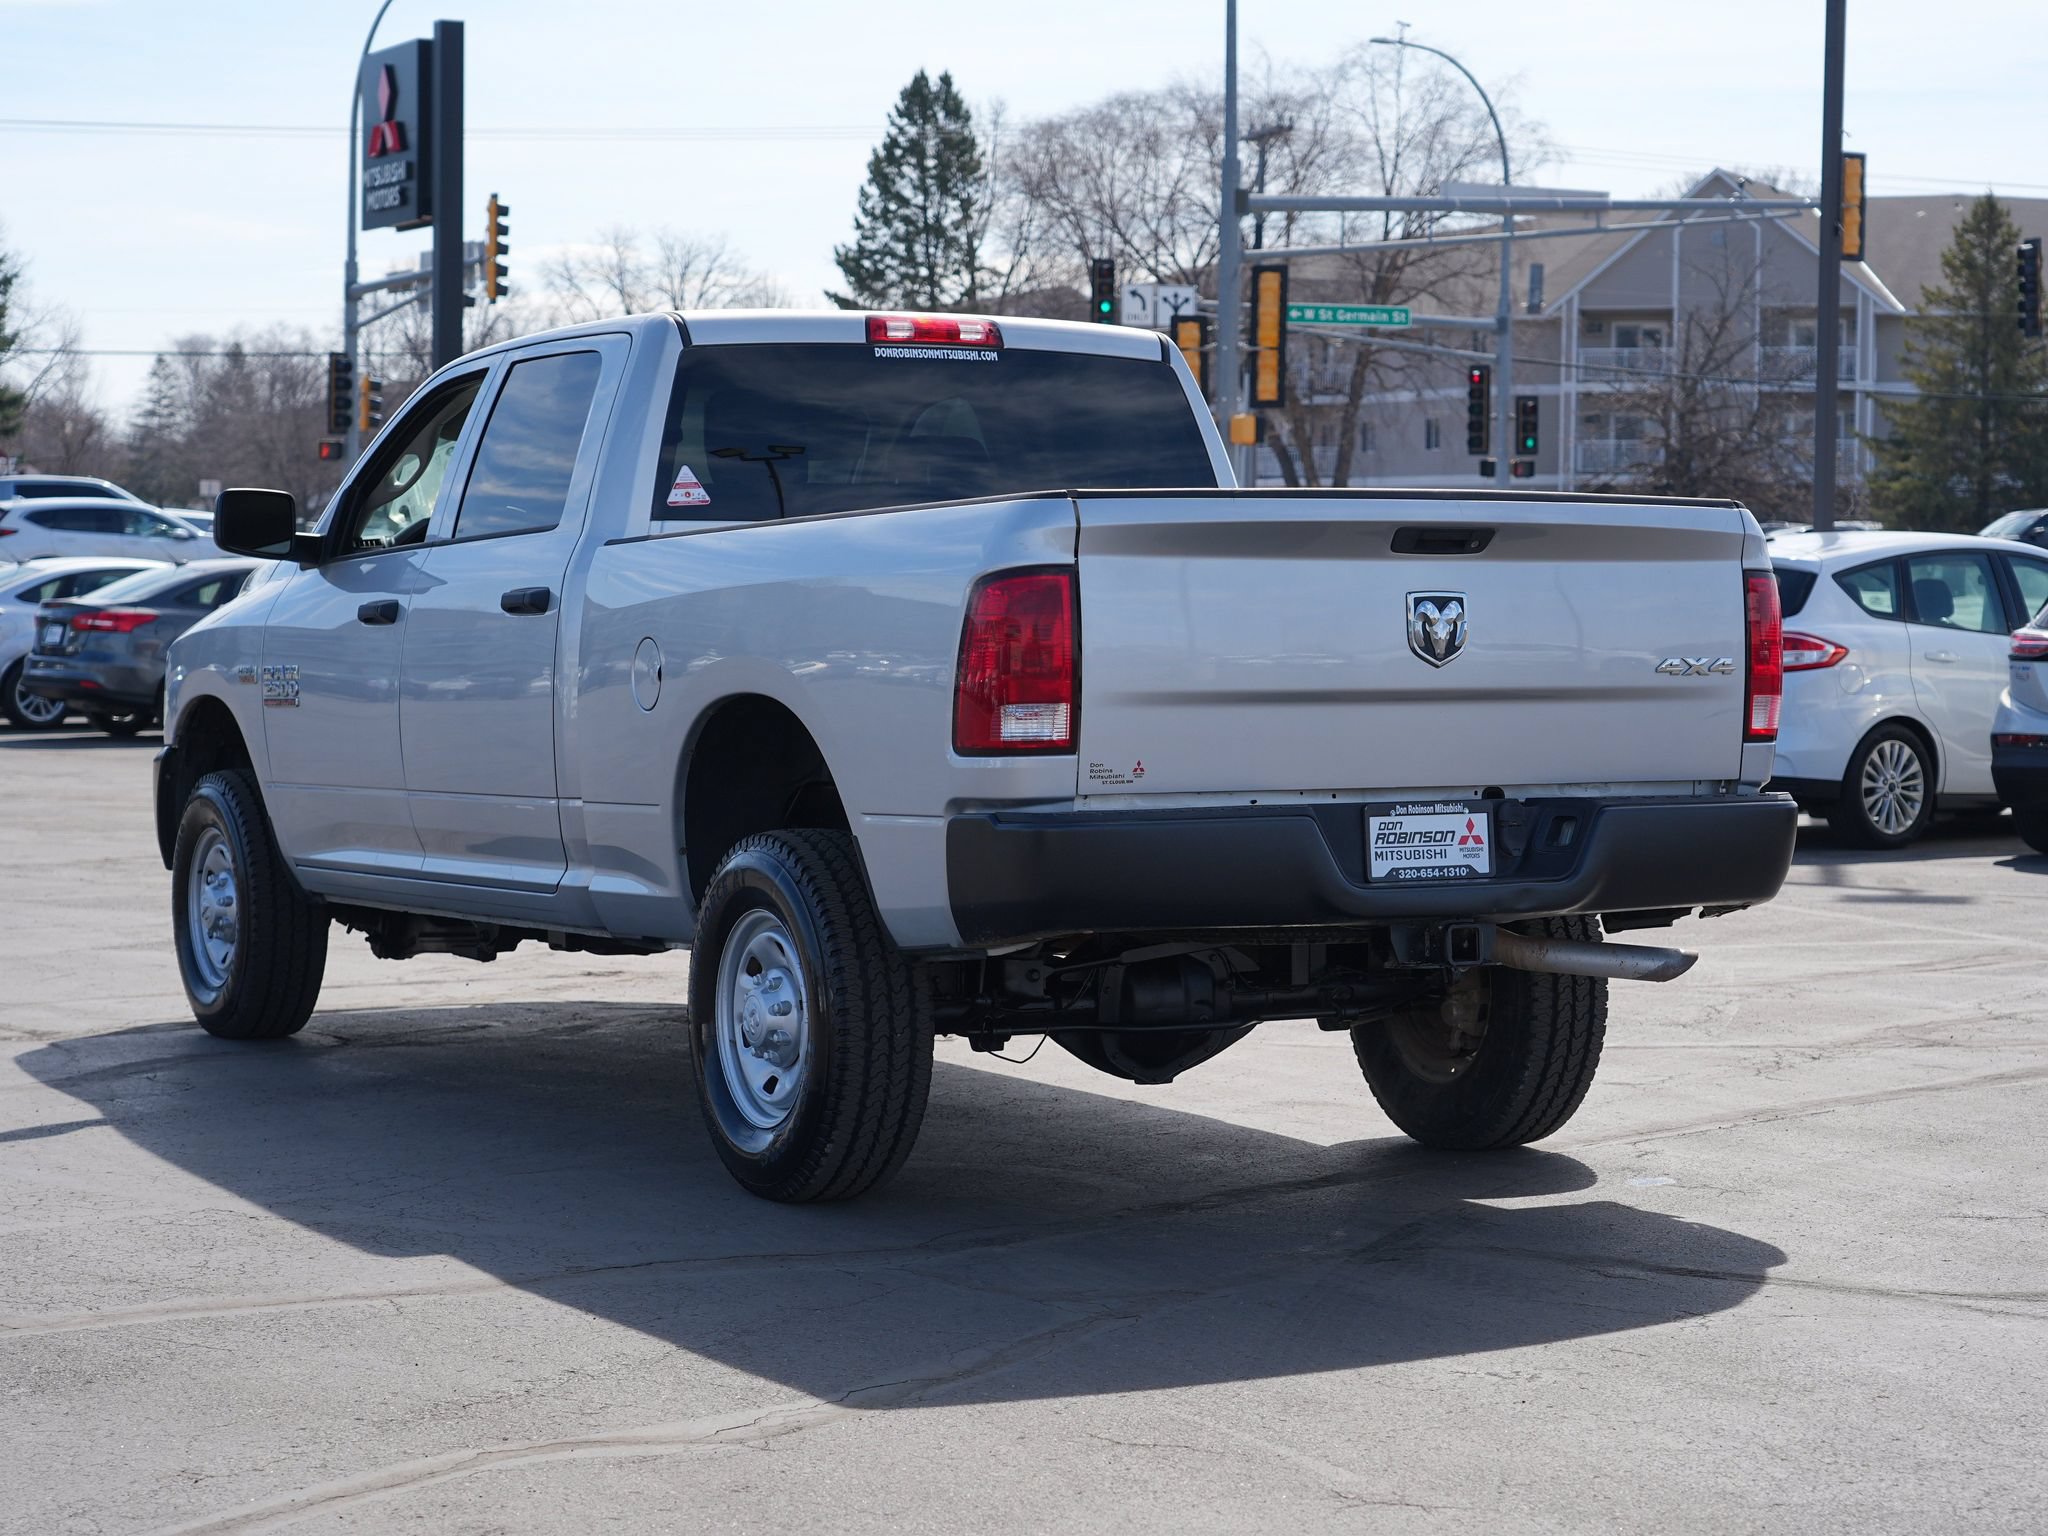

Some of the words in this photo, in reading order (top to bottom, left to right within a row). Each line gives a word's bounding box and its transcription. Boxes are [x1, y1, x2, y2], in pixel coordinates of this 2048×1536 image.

[367, 185, 400, 211] MOTORS
[1304, 308, 1315, 320] W
[1318, 308, 1333, 321] St
[1336, 309, 1389, 322] Germain
[1391, 310, 1406, 323] St
[874, 347, 998, 361] DONROBINSONMITSUBISHI.COM
[1655, 657, 1736, 676] 4X4
[1396, 805, 1407, 815] Don
[1408, 804, 1434, 814] Robinson
[1434, 803, 1464, 813] Mitsubishi
[1374, 849, 1447, 861] MITSUBISHI
[1398, 866, 1467, 878] 320-654-1310
